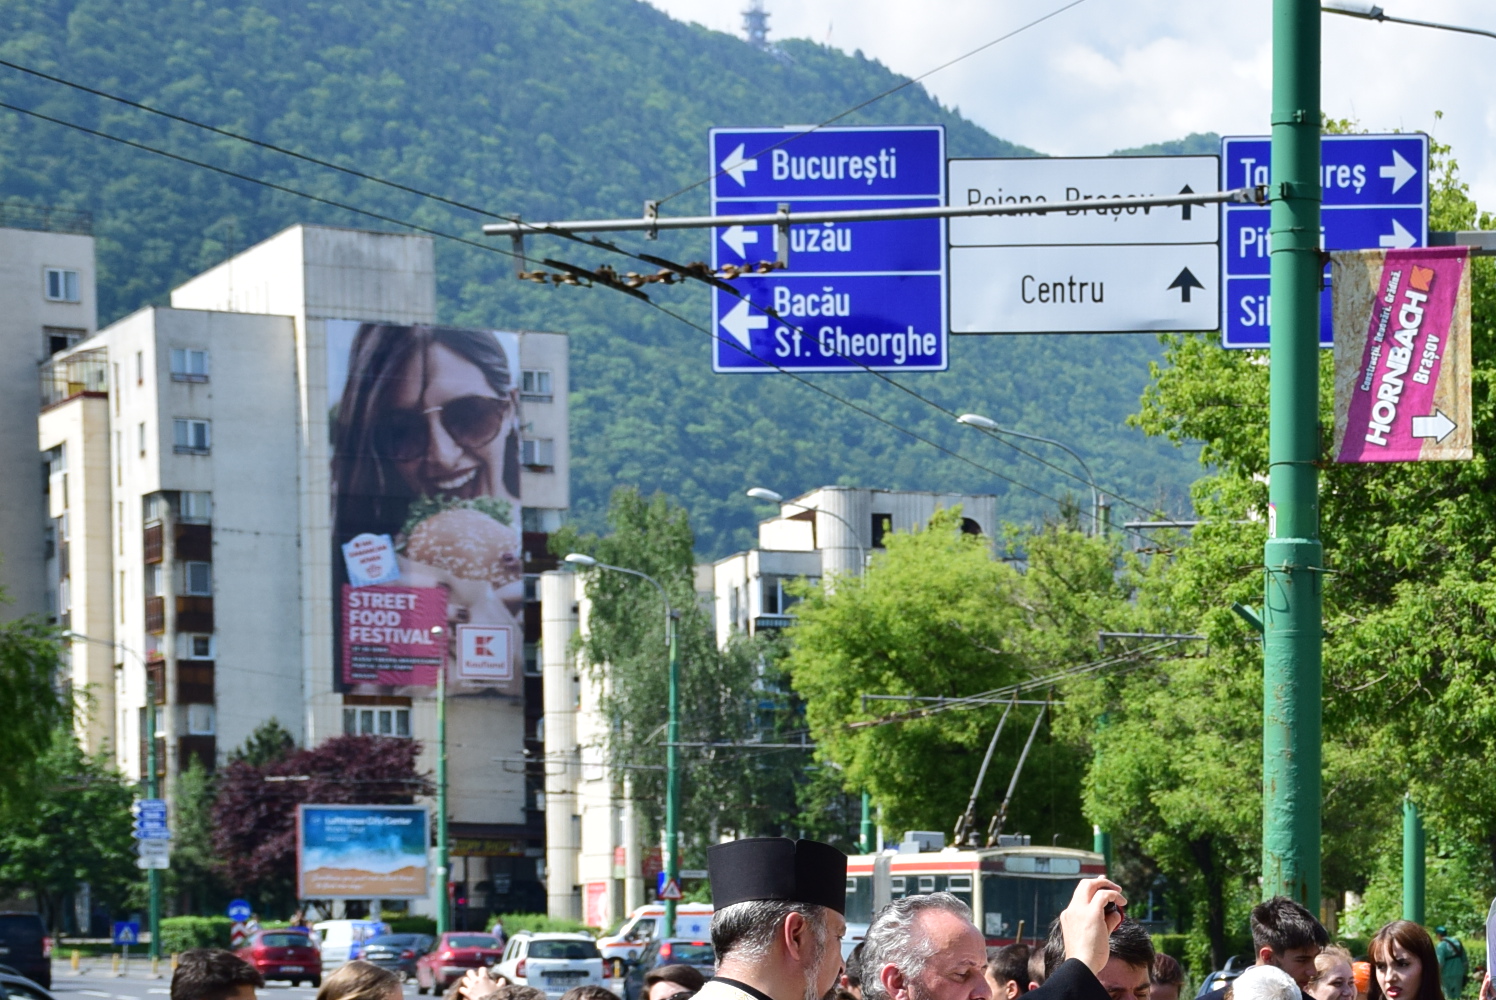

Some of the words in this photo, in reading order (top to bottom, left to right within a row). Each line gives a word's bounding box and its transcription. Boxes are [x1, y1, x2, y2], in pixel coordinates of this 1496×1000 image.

[772, 147, 897, 185] București
[773, 222, 852, 252] uzău
[774, 286, 850, 317] Bacău
[1021, 274, 1104, 304] Centru
[818, 325, 937, 365] Gheorghe
[1413, 333, 1440, 385] Brașov
[1365, 289, 1429, 446] HORNBACH
[349, 592, 418, 610] STREET
[349, 609, 401, 626] FOOD
[349, 626, 435, 645] FESTIVAL
